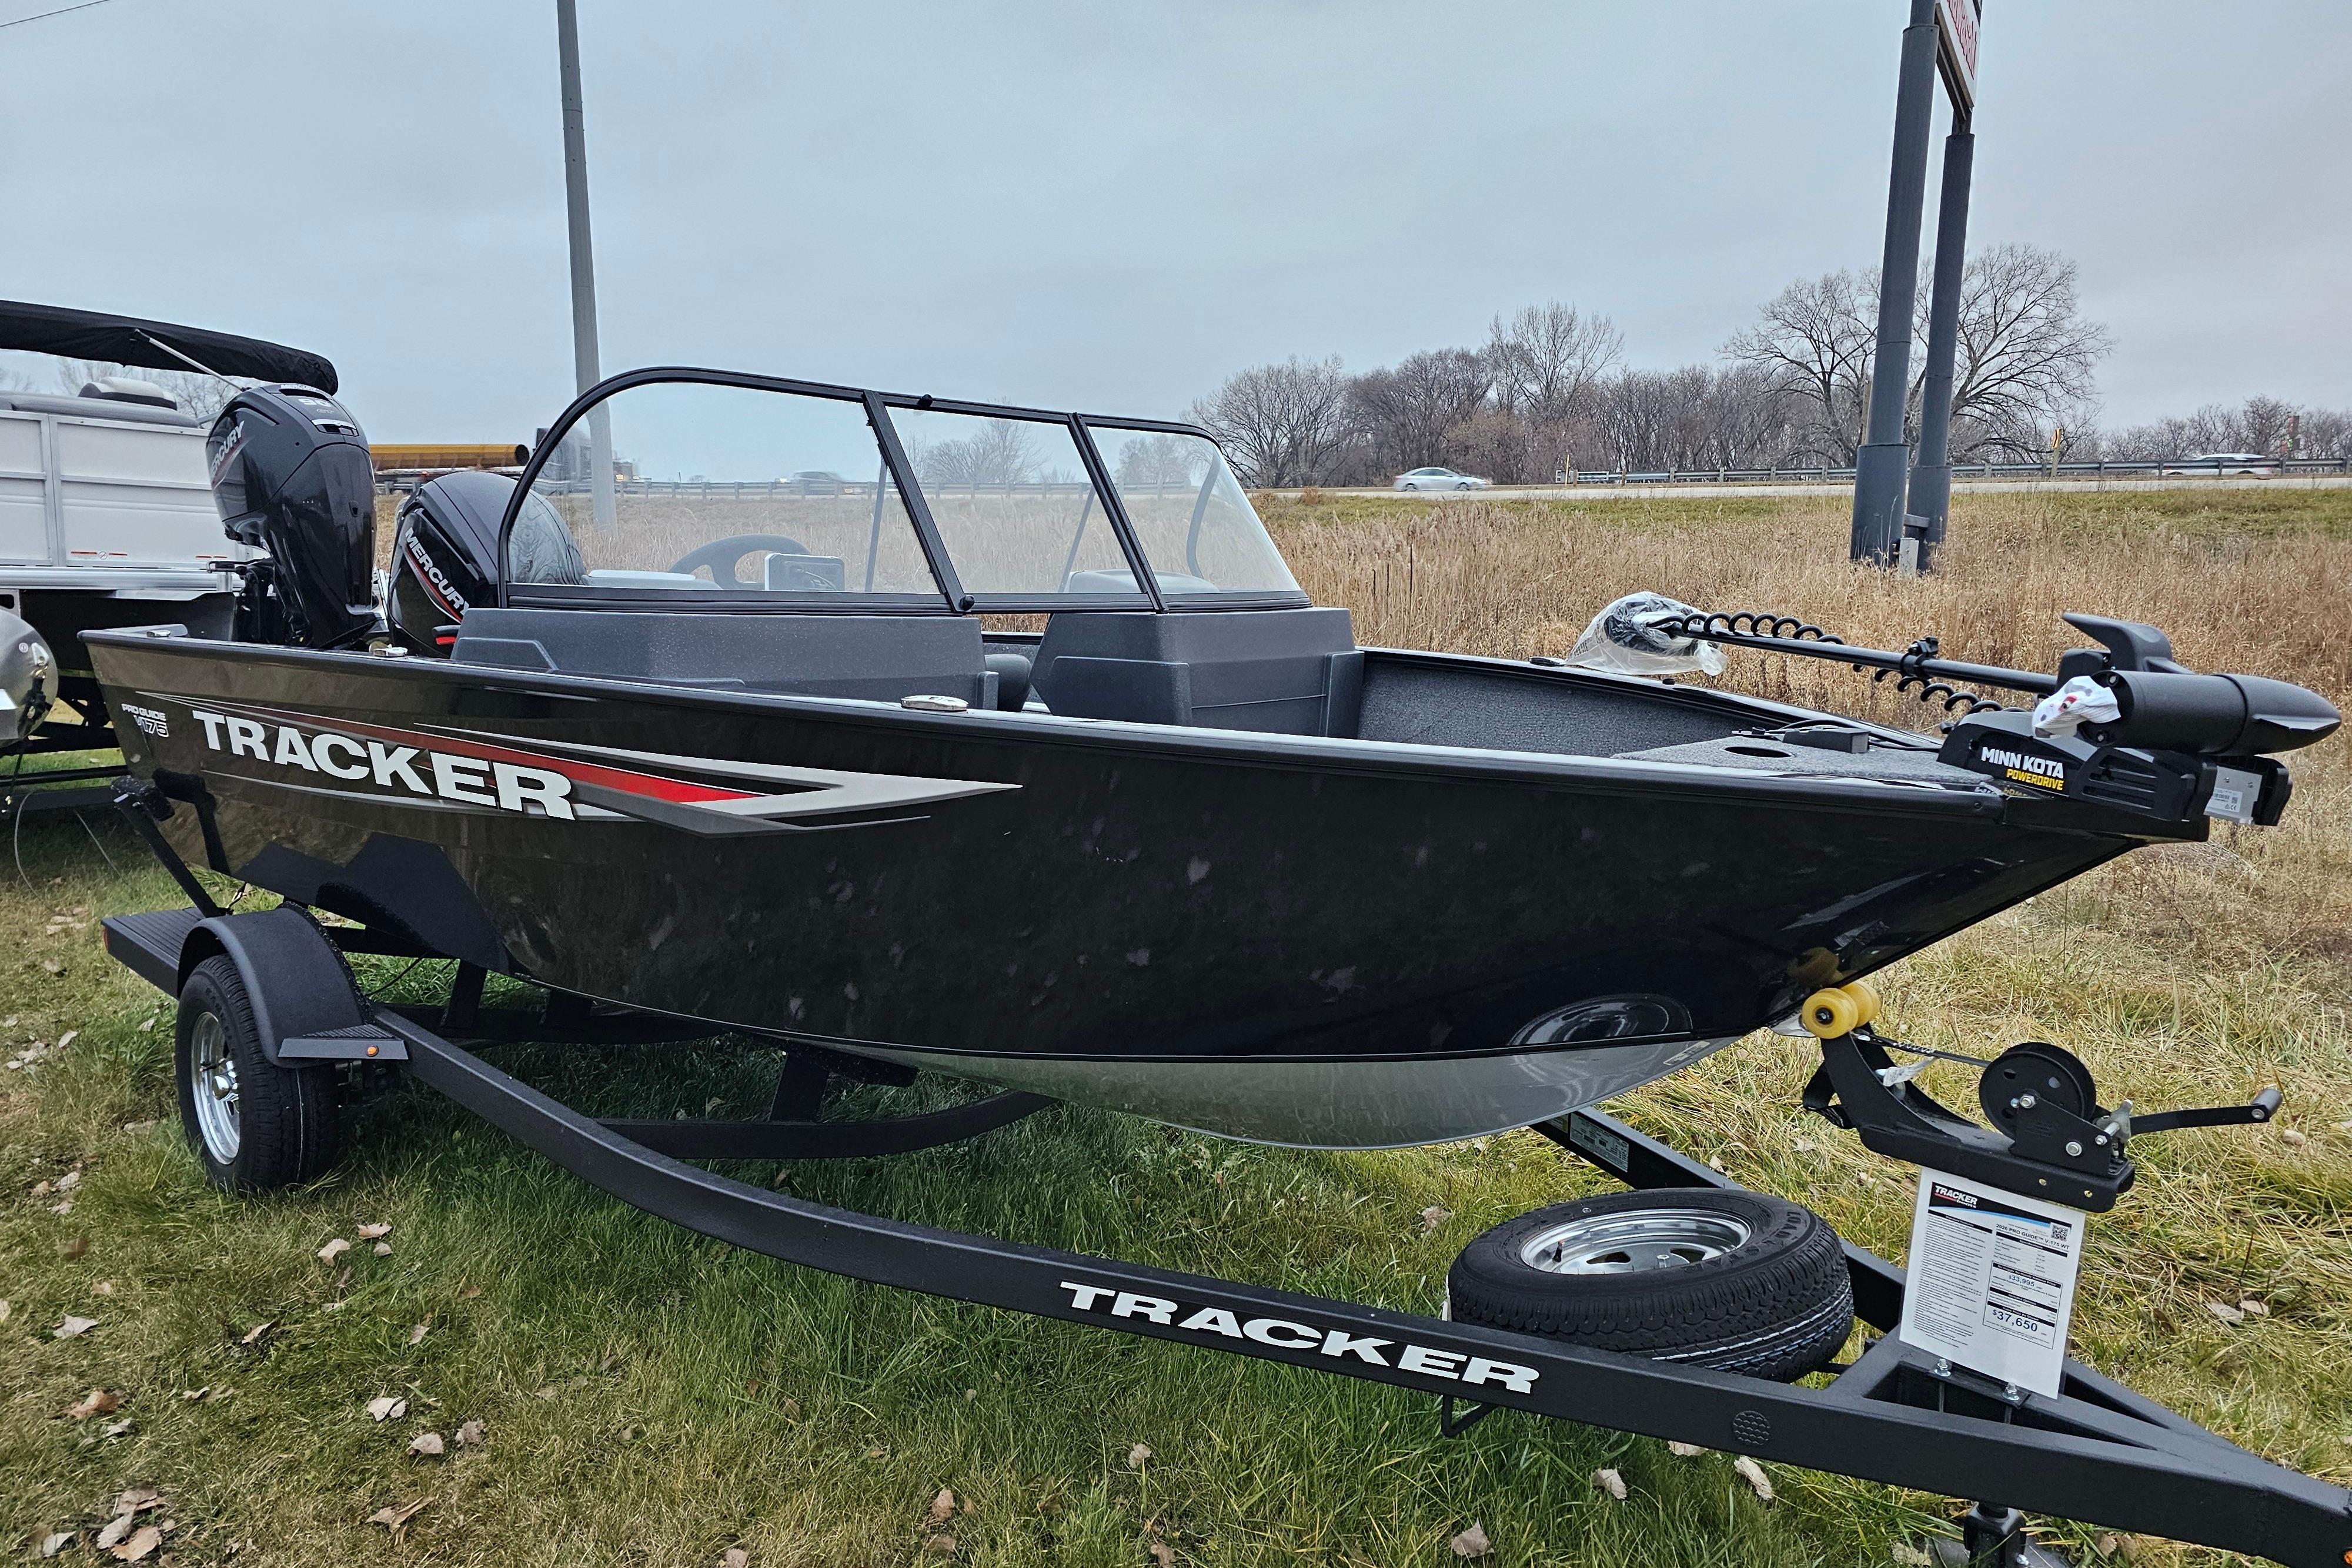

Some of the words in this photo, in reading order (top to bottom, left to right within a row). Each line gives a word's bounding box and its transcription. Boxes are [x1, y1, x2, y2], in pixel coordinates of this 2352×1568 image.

[405, 527, 470, 616] MERCURY
[121, 703, 139, 714] PRO
[139, 707, 166, 721] GUIDE
[192, 710, 576, 821] TRACKER
[1981, 747, 2022, 769] MINN
[2022, 755, 2064, 779] KOTA
[2006, 768, 2064, 791] POWERDRIVE
[1935, 1185, 1978, 1205] TRACKER
[1992, 1309, 2037, 1332] $37,650
[1060, 1281, 1539, 1394] TRACKER
